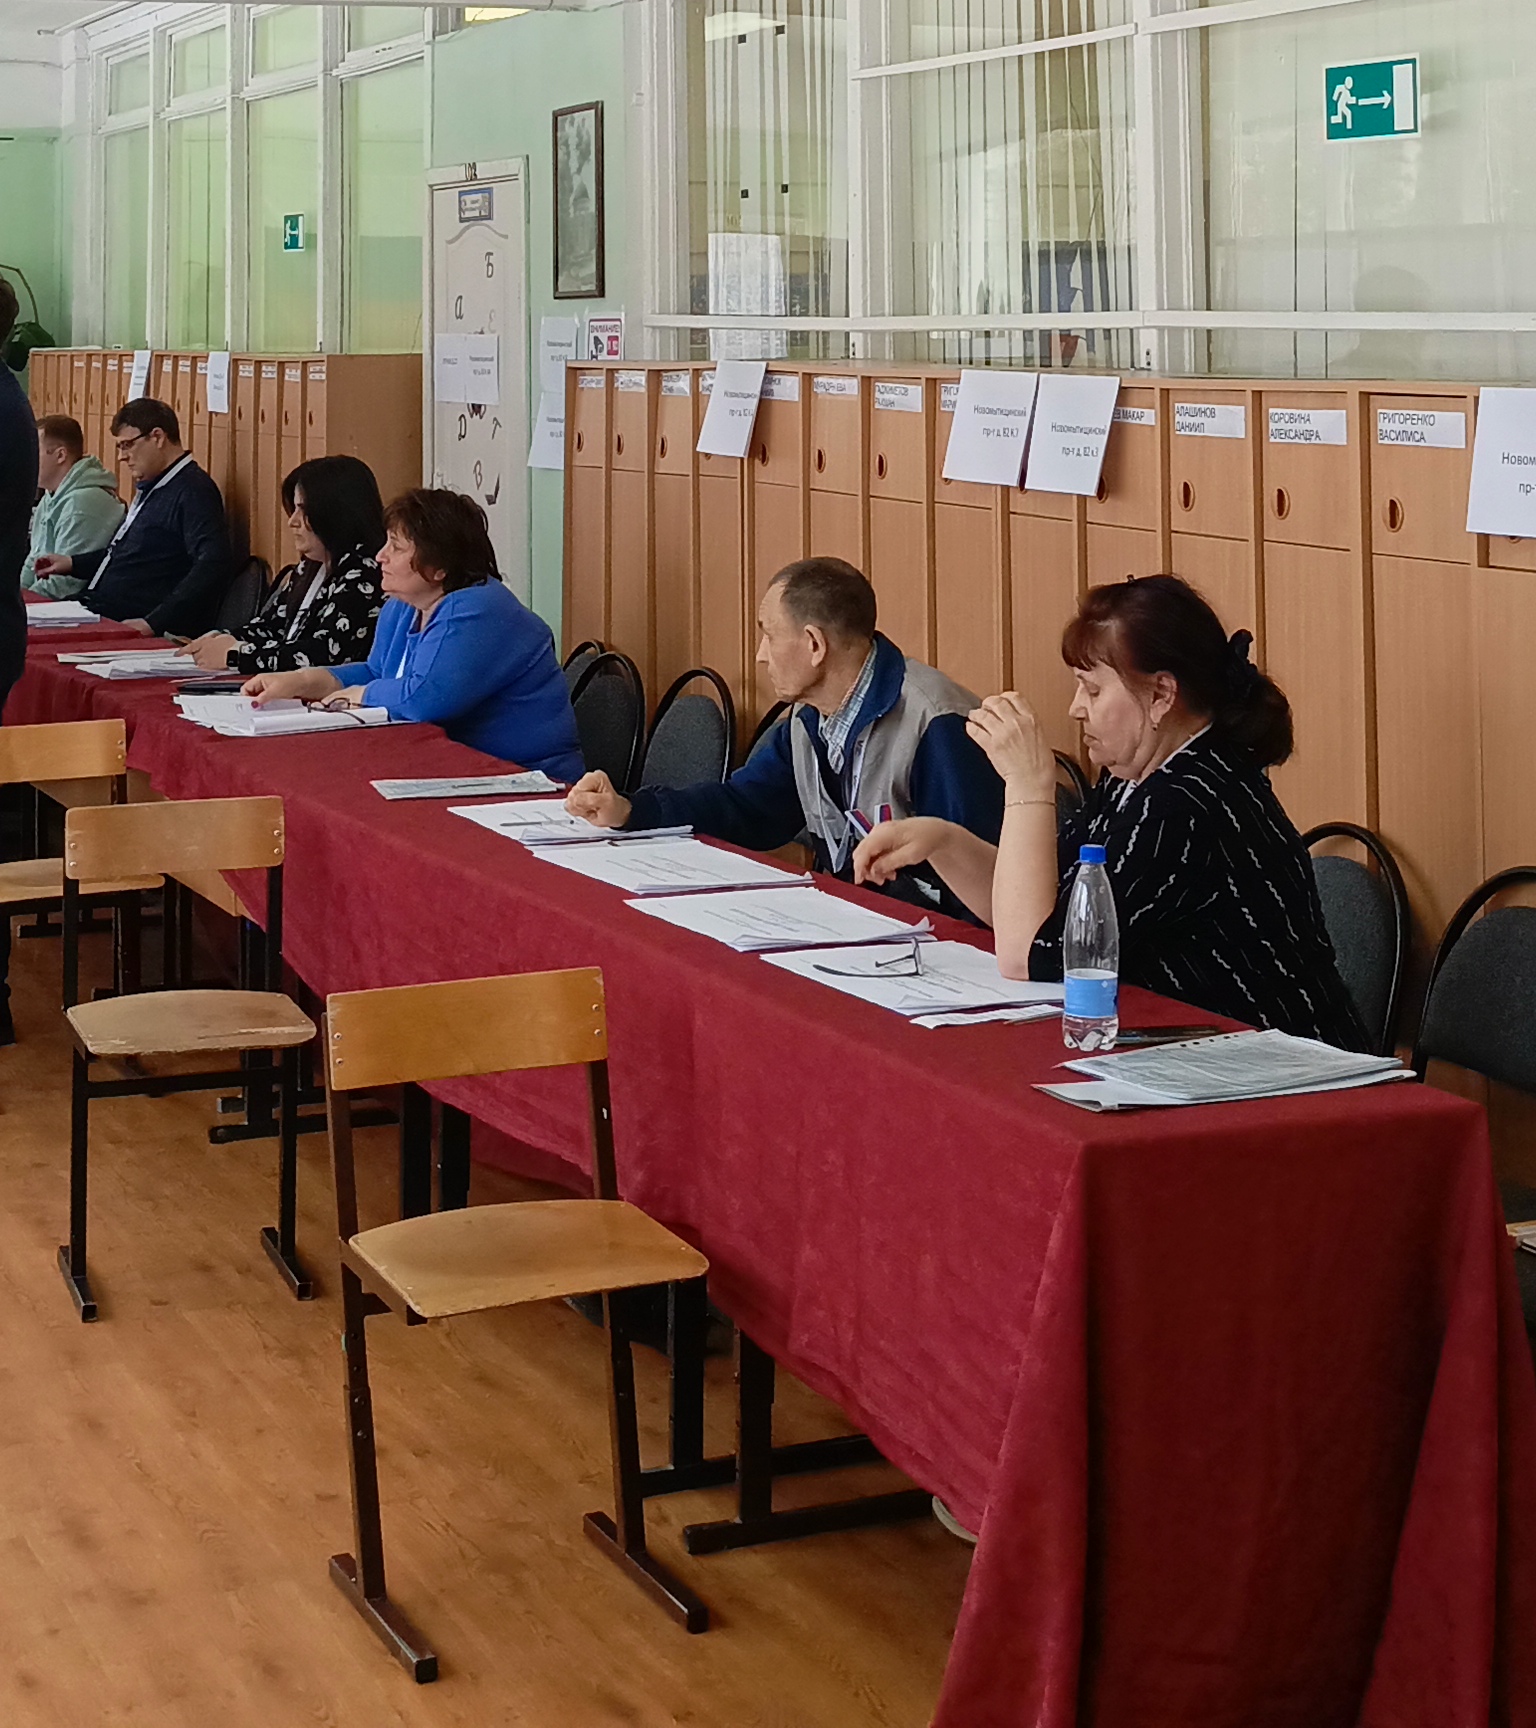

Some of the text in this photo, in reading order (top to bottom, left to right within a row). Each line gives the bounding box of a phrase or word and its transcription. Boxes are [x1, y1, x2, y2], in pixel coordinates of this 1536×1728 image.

[1122, 409, 1145, 421] МАКАР
[1175, 405, 1216, 419] АЛАШИНОВ
[1269, 411, 1312, 425] КОРОВИНА
[1378, 411, 1436, 426] ГРИГОРЕНКО
[1175, 421, 1205, 434] ДАНИИЛ
[1270, 428, 1322, 442] АЛЕКСАНДРА
[1378, 429, 1426, 443] ВАСИЛИСА
